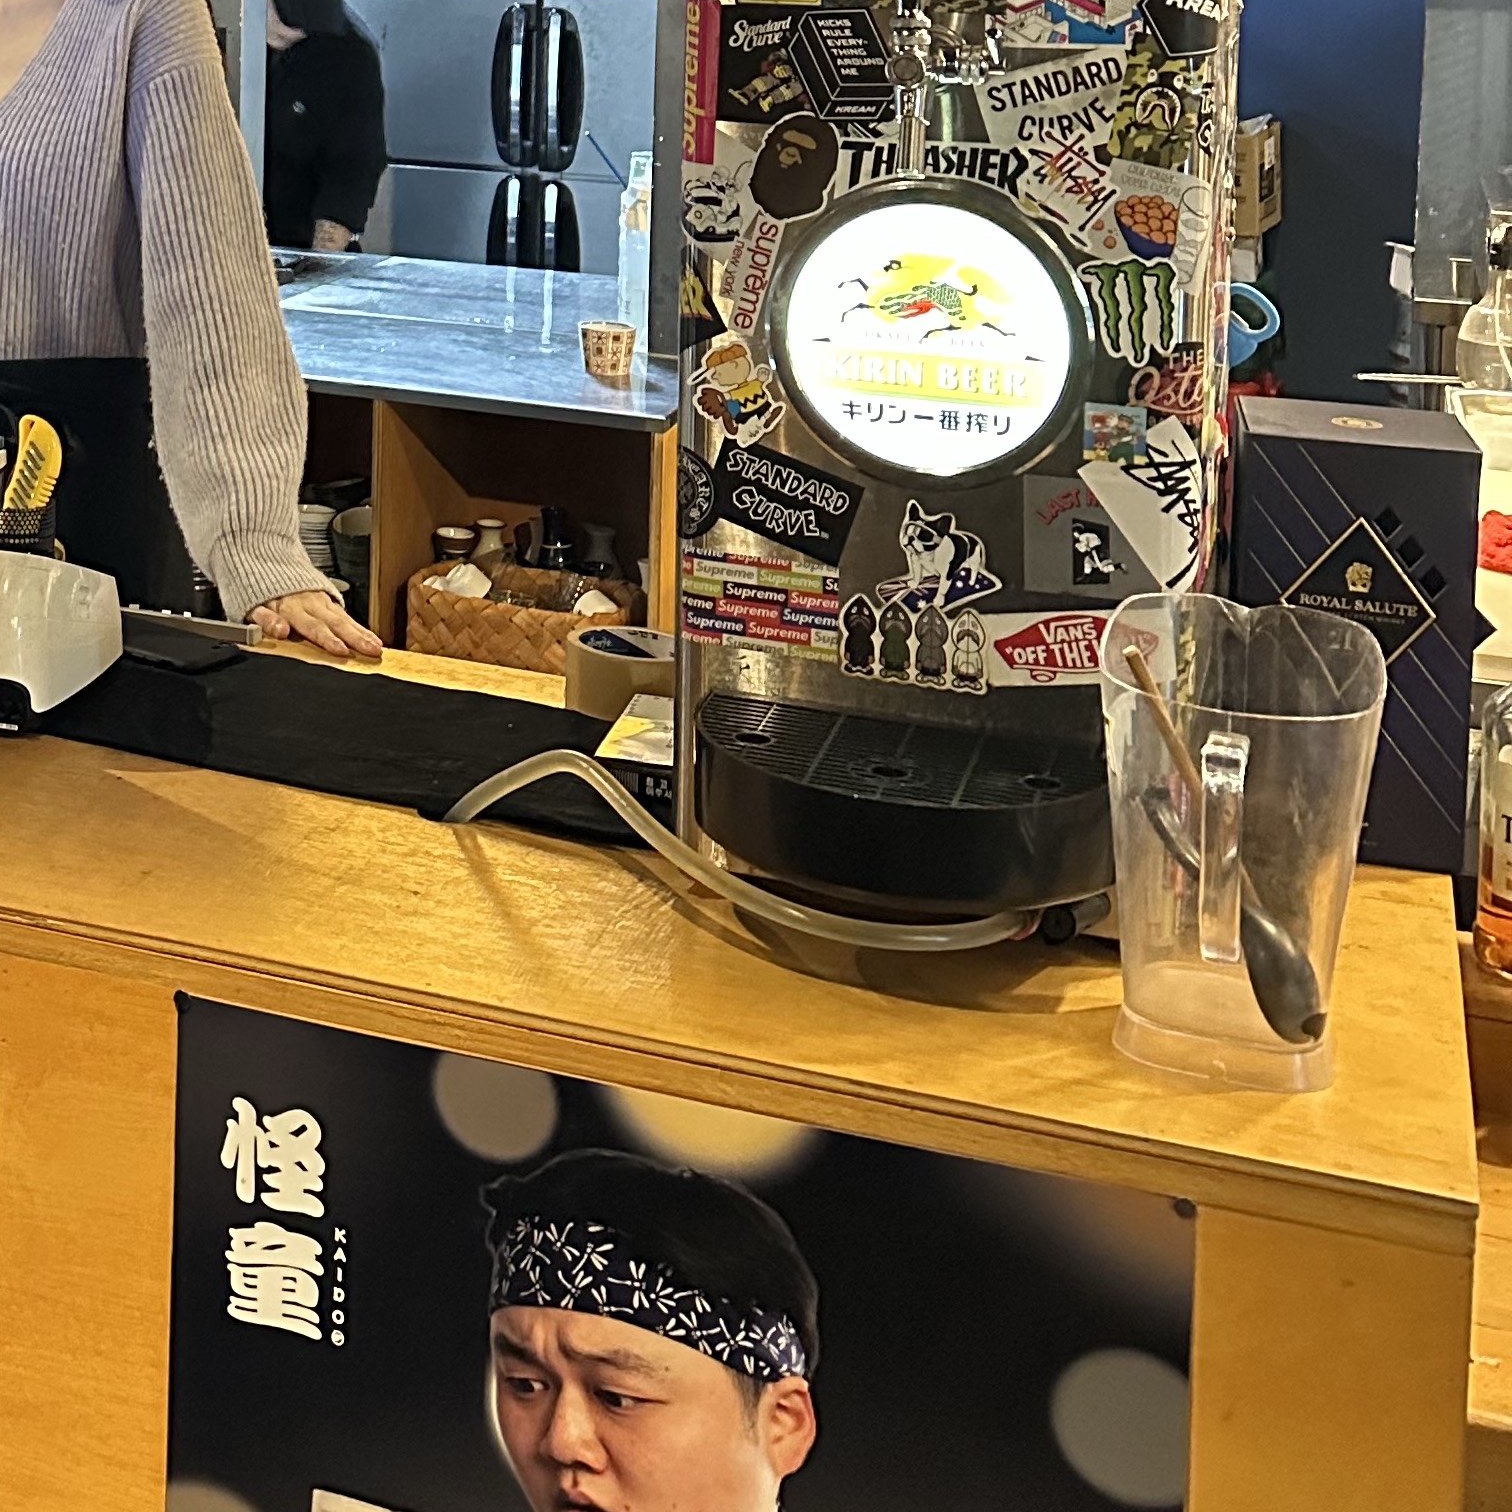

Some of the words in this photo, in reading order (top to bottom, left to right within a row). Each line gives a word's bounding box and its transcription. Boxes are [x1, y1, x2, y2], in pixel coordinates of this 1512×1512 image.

[817, 19, 851, 27] KICKS
[822, 29, 853, 37] RULE
[831, 48, 867, 56] THING
[837, 57, 884, 66] AROUND
[841, 68, 859, 76] ME
[988, 57, 1123, 112] STANDARD
[834, 106, 876, 114] KREAM
[1018, 97, 1115, 141] CURVE
[840, 140, 1029, 200] THASHER
[726, 448, 849, 515] STANDARD
[732, 486, 820, 537] CURVE
[695, 561, 755, 580] Supreme
[759, 570, 821, 589] Supreme
[725, 583, 787, 602] Supreme
[1299, 592, 1352, 610] ROYAL
[1354, 599, 1419, 617] SALUTE
[717, 599, 779, 619] Supreme
[687, 612, 744, 633] Supreme
[748, 622, 810, 642] Supreme
[1039, 617, 1097, 643] VANS
[1049, 639, 1095, 668] THE
[221, 1097, 326, 1340] 怪童
